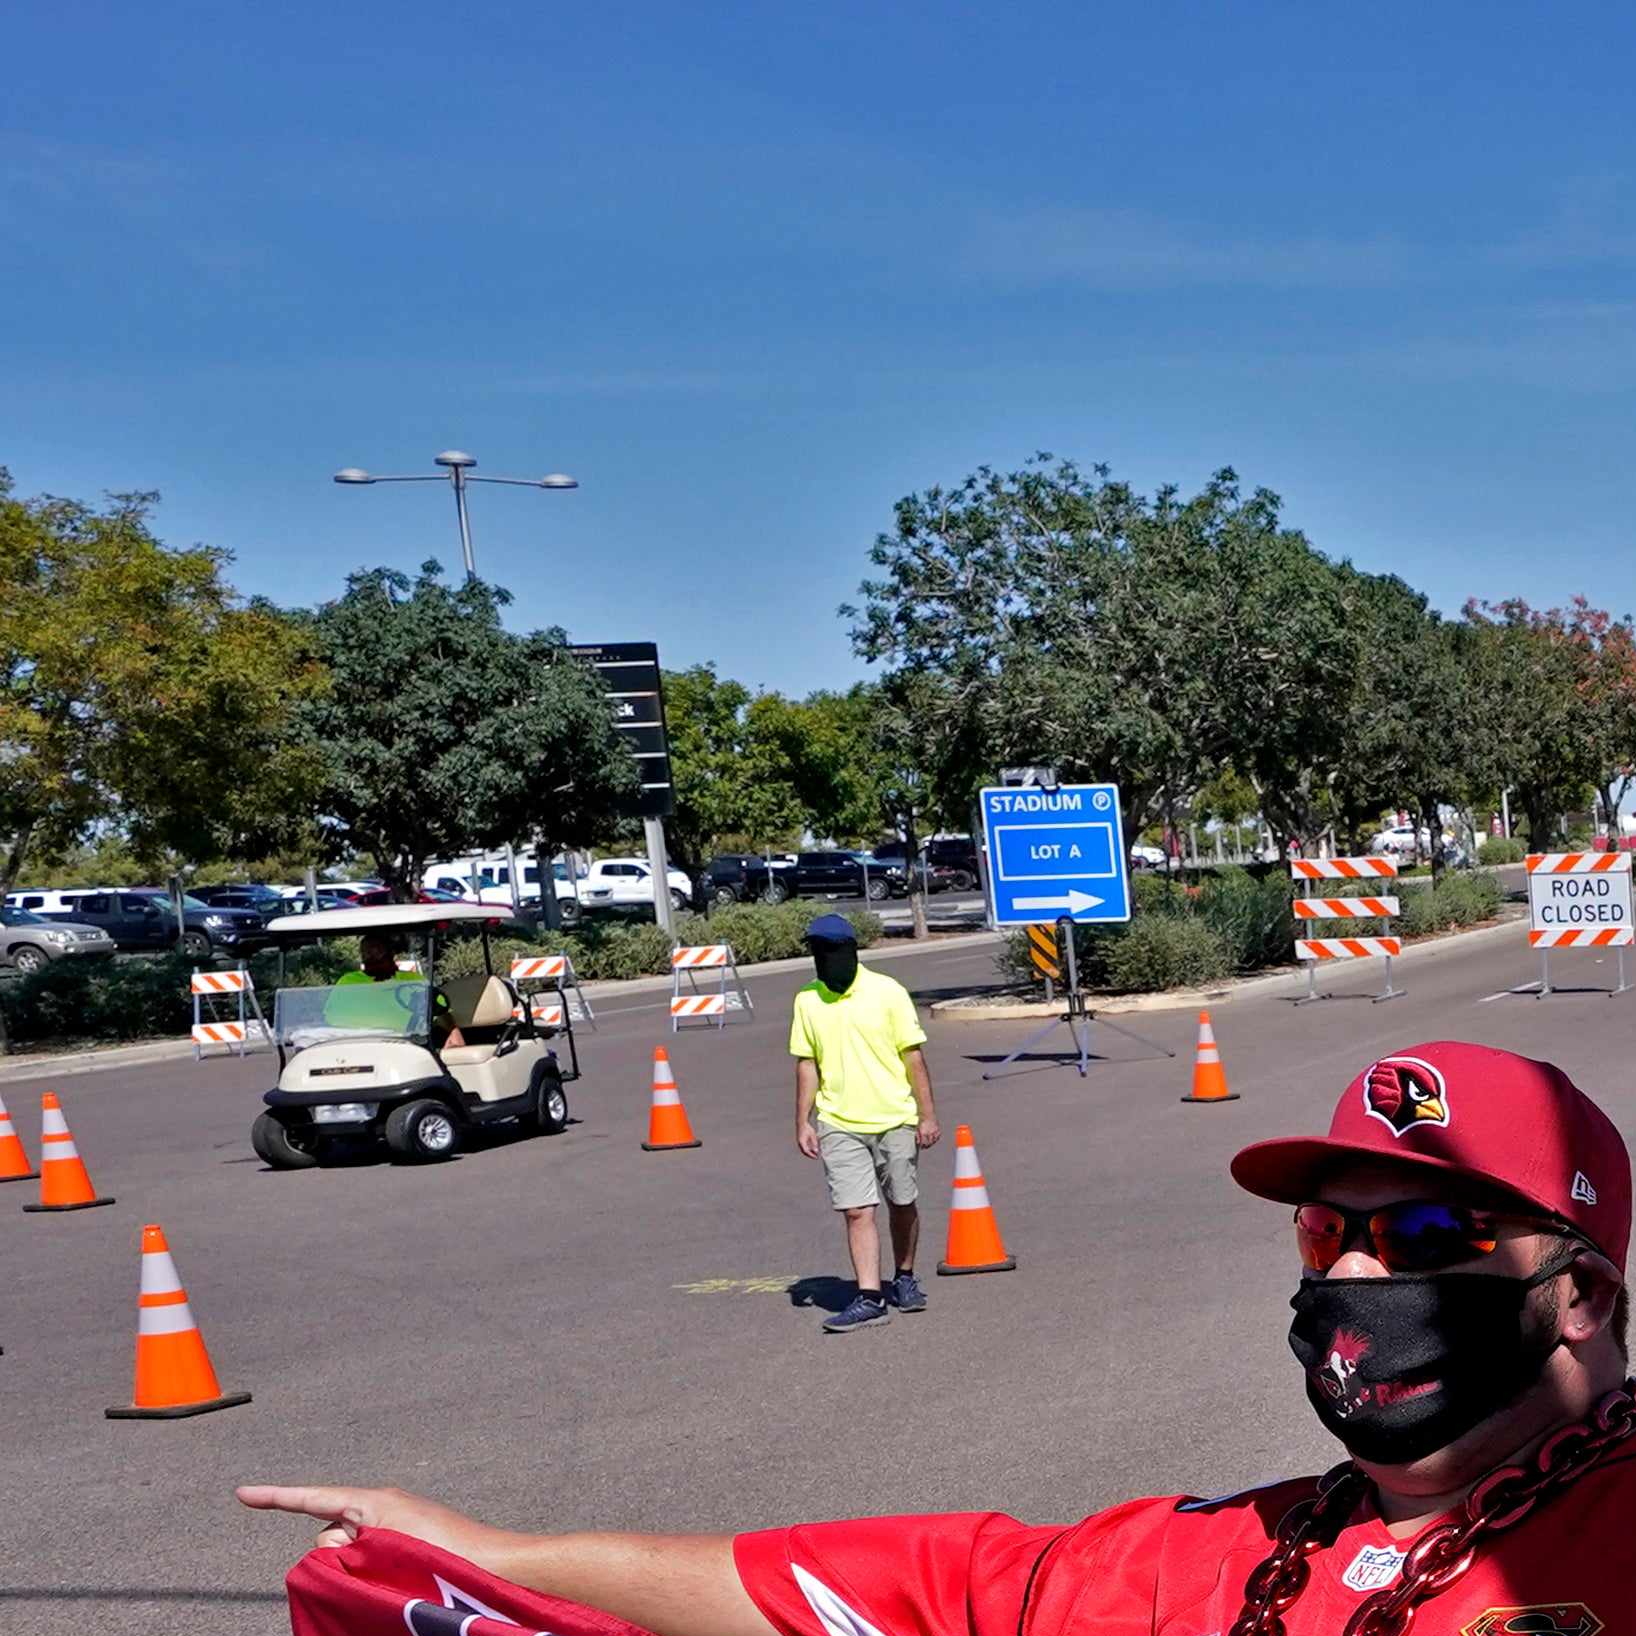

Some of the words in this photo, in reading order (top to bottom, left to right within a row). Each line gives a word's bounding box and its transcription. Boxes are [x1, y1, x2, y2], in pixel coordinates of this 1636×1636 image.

[990, 794, 1082, 813] STADIUM
[1030, 845, 1061, 859] LOT
[1069, 844, 1082, 858] A
[1551, 879, 1610, 898] ROAD
[1541, 904, 1624, 924] CLOSED
[1351, 1564, 1386, 1585] NFL
